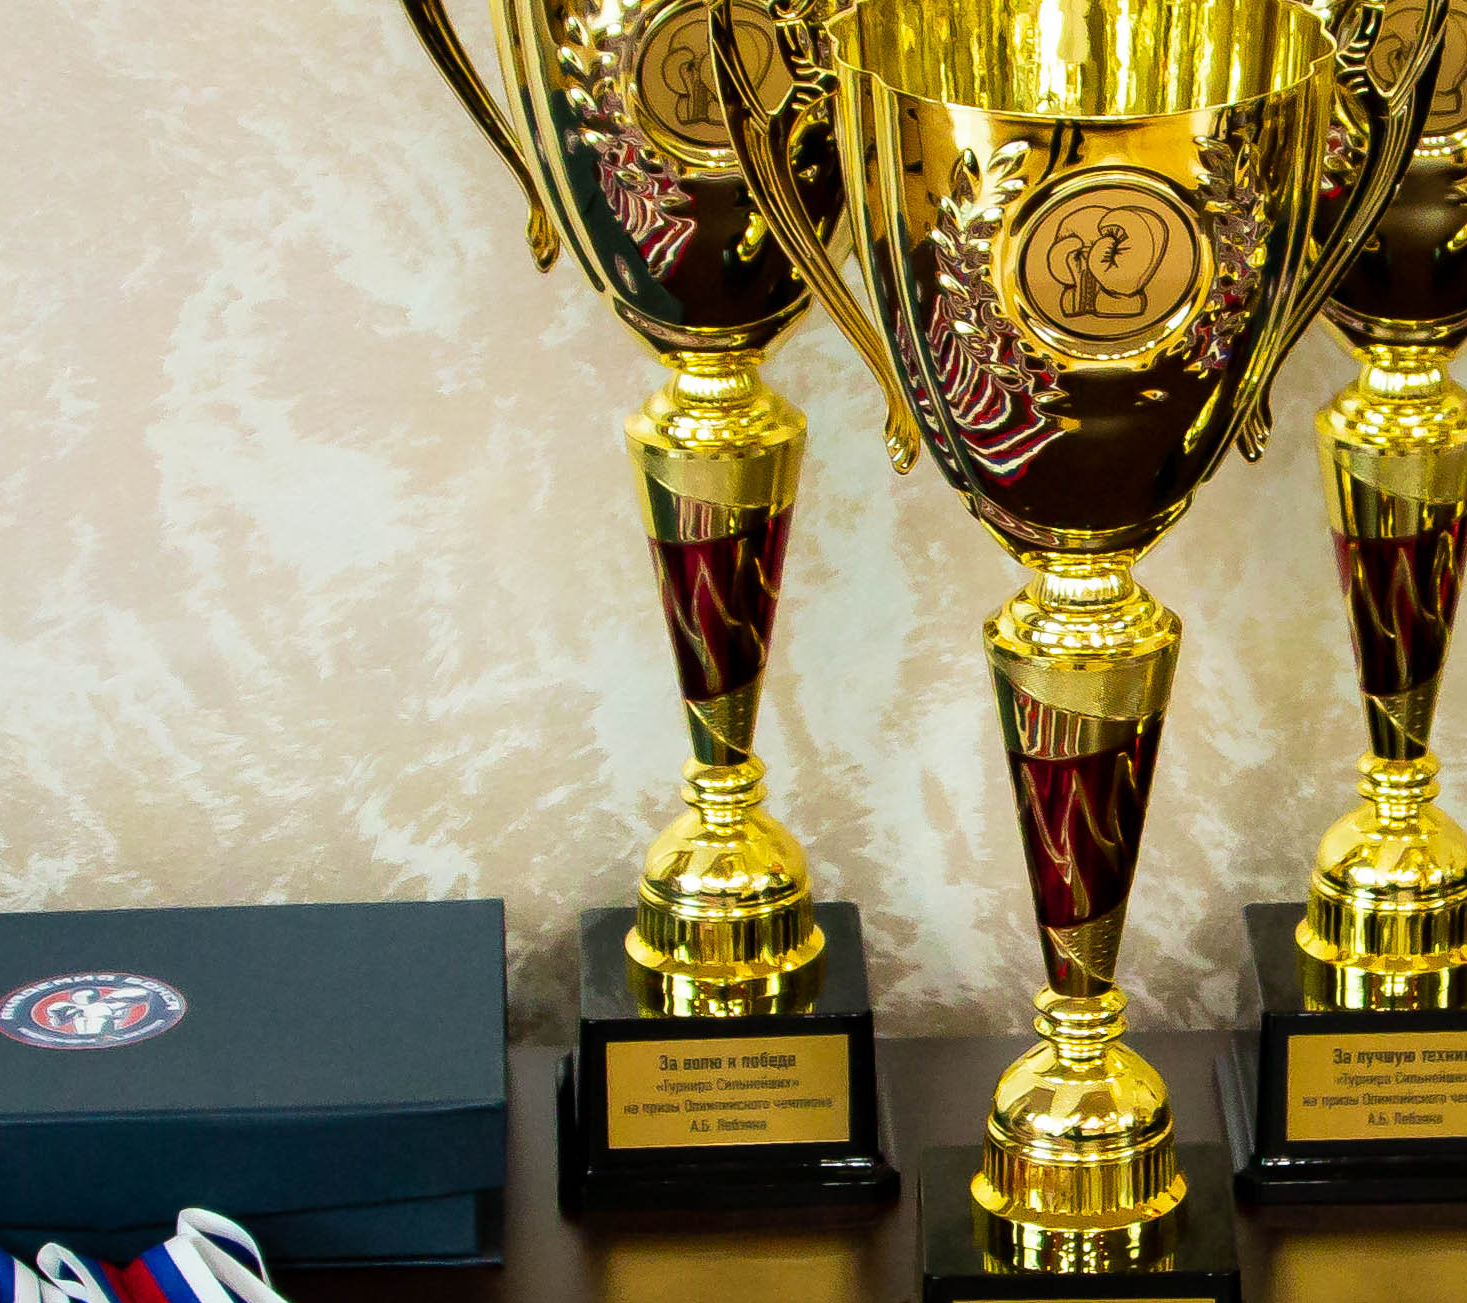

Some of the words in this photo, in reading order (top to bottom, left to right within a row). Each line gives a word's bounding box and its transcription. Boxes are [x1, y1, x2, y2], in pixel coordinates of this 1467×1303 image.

[658, 1054, 678, 1071] За
[683, 1055, 722, 1070] волю
[727, 1056, 737, 1069] к
[741, 1052, 797, 1070] победе
[1333, 1048, 1351, 1065] За
[1357, 1050, 1416, 1067] лучшую
